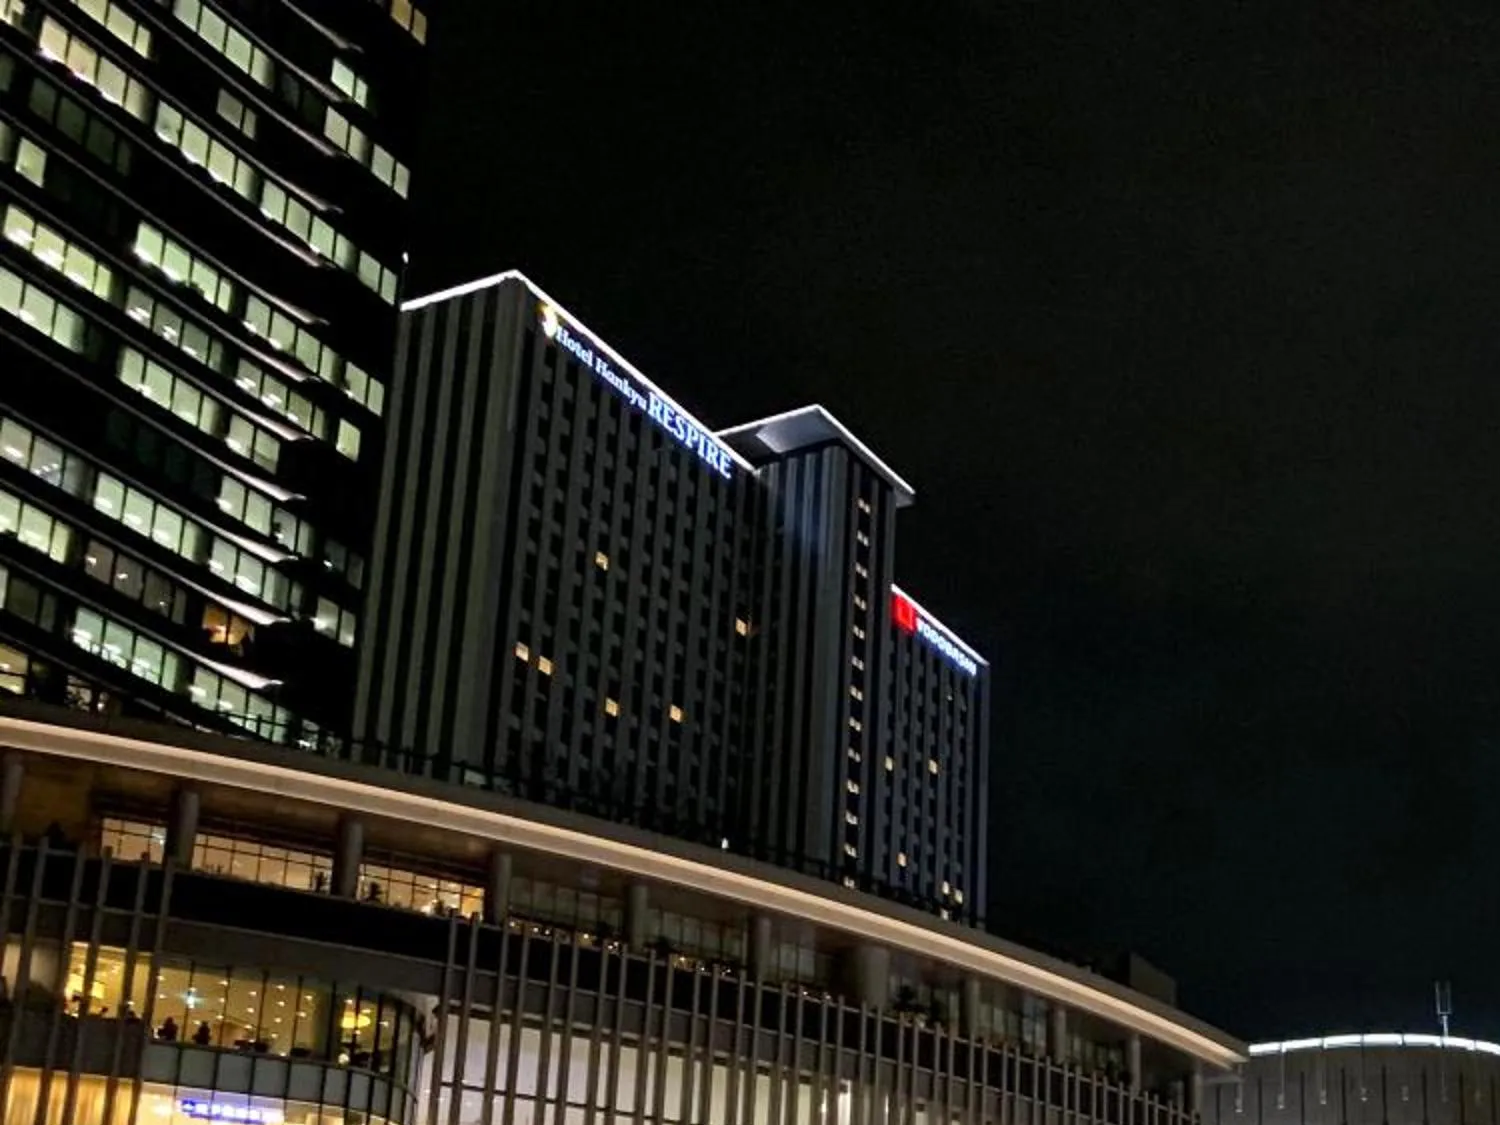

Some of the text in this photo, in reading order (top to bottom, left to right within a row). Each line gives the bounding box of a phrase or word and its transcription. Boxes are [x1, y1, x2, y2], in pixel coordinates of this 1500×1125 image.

[556, 326, 732, 479] Hotel Hankyu RESPIRE
